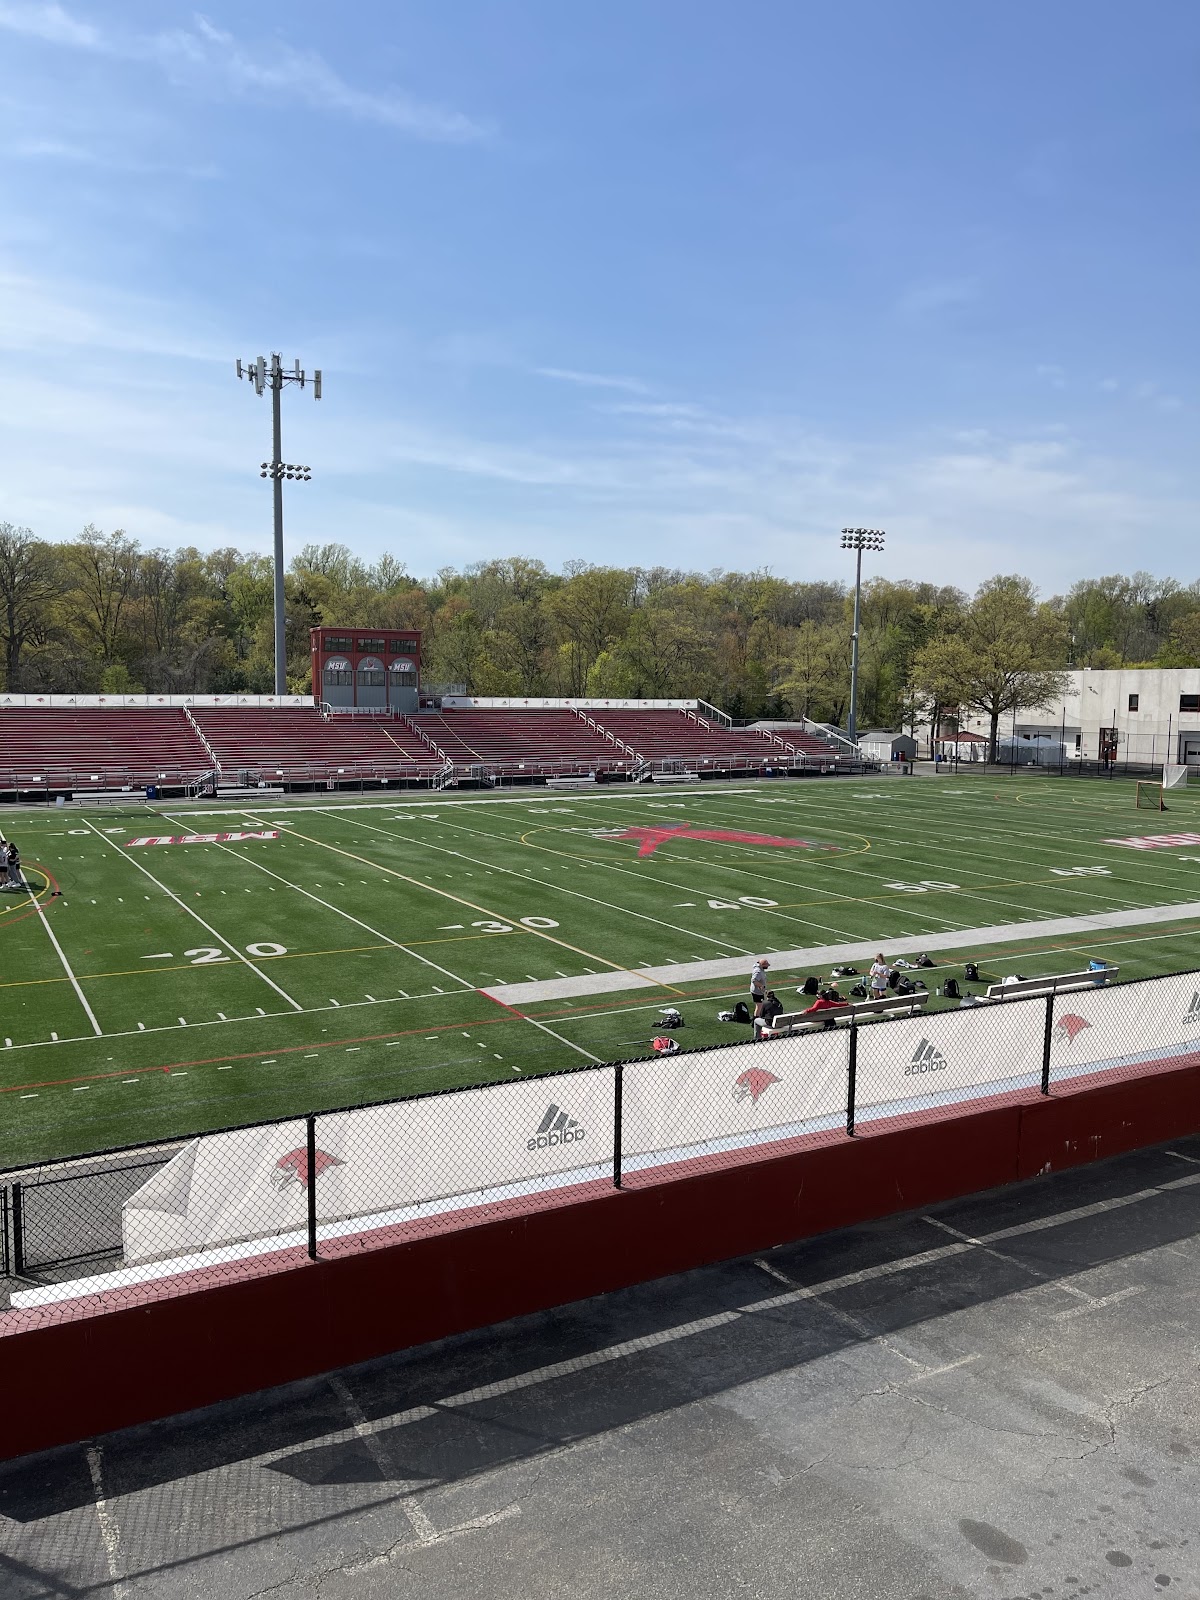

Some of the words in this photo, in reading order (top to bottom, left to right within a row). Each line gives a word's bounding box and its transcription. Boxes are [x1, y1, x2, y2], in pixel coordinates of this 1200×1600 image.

[328, 661, 347, 670] MSU
[393, 662, 412, 671] MSU
[124, 830, 278, 847] MSU
[882, 880, 961, 893] 50
[707, 896, 779, 909] 40
[470, 916, 560, 933] 30
[184, 942, 288, 964] 20
